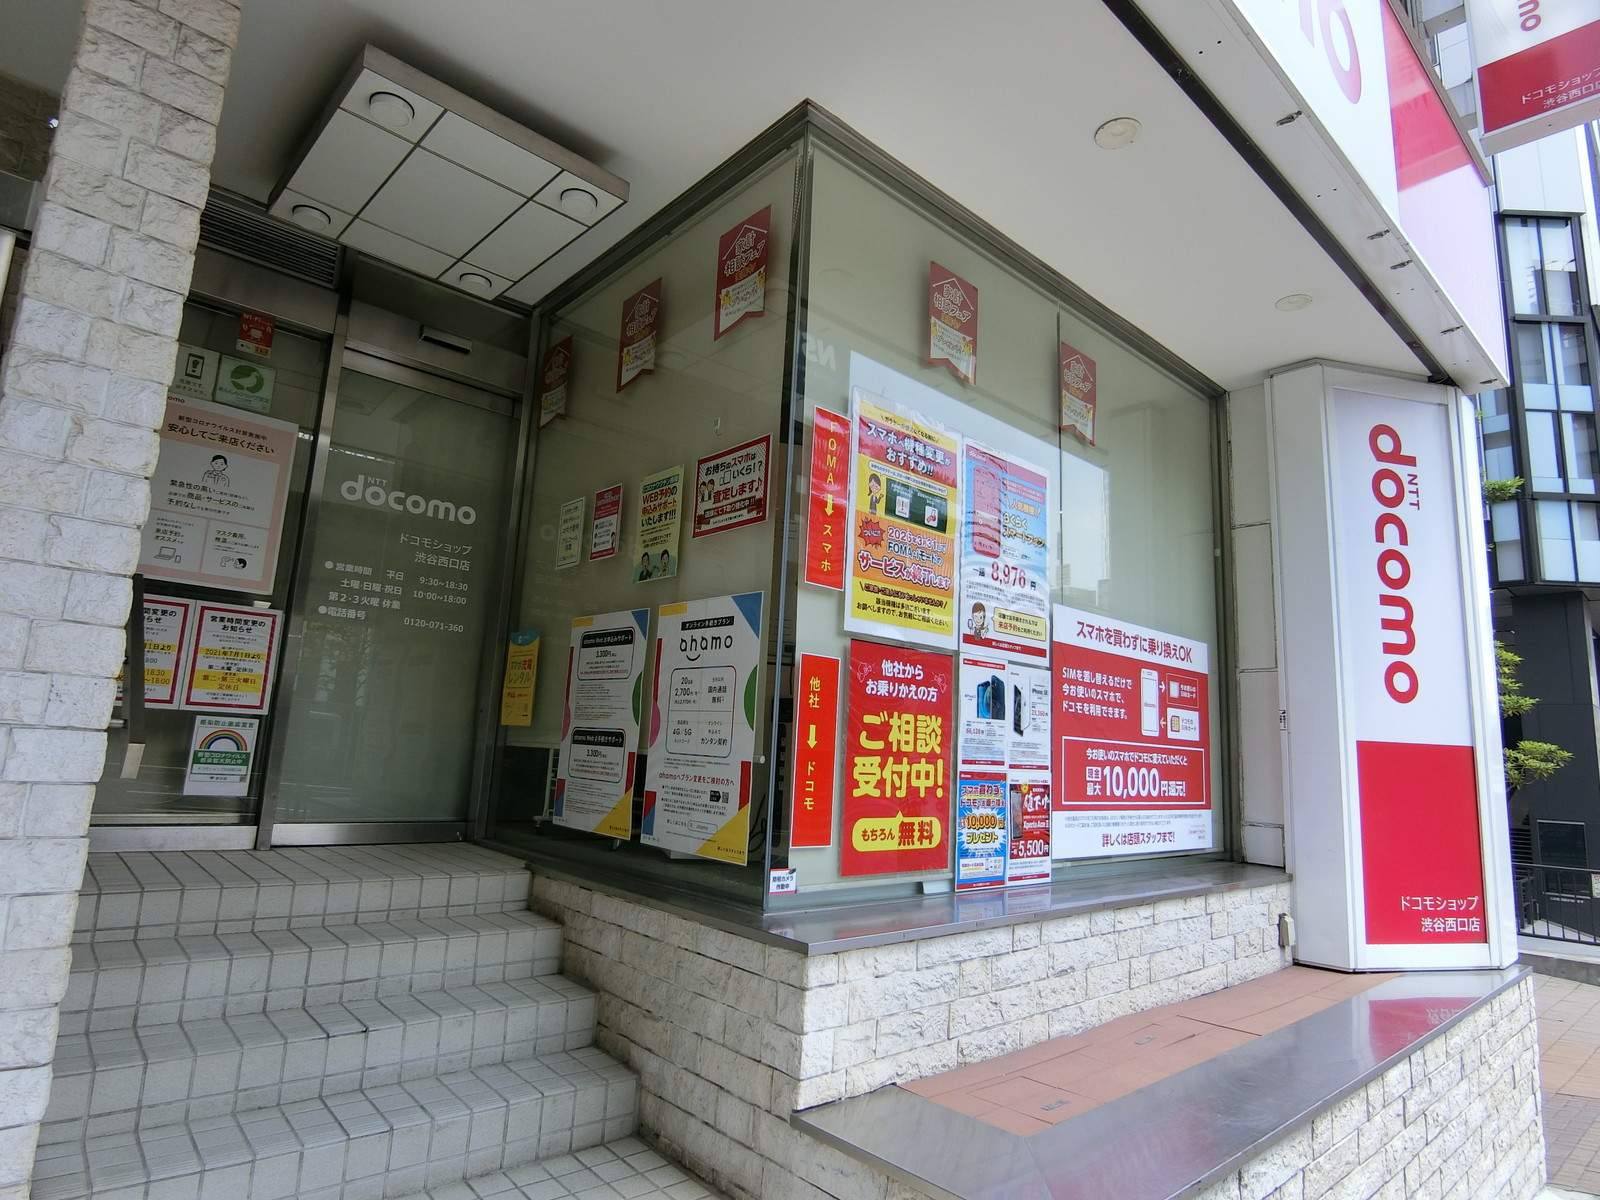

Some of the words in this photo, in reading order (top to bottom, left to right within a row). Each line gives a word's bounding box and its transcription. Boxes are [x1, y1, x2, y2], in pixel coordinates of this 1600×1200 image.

[168, 423, 275, 454] 安心してご来店ください
[826, 421, 838, 485] FOMA
[705, 452, 756, 476] お持ちのスマホは
[367, 476, 388, 487] NTT
[1407, 473, 1420, 511] NTT
[340, 474, 477, 525] docomo
[642, 485, 678, 505] WEB予約の
[641, 498, 677, 516] 申込みサポート
[1003, 511, 1028, 531] らくらく
[400, 532, 473, 555] ドコモショップ
[820, 524, 833, 572] スマホ
[336, 562, 373, 576] 営業時間
[386, 569, 404, 581] 平日
[414, 551, 471, 572] 渋谷西口店
[857, 549, 952, 591] サービスが終了します
[1368, 424, 1419, 704] docomo
[991, 560, 1026, 589] 8,976
[1030, 580, 1037, 591] 円
[210, 615, 266, 628] 営業時間変更の
[221, 624, 253, 634] お知らせ
[327, 606, 367, 621] 電話番号
[404, 617, 464, 633] 0120-071-360
[679, 634, 733, 652] ahamo
[1076, 620, 1193, 664] スマホを買わずに乗り換えOK
[205, 648, 261, 659] 2021年7月1日より
[881, 659, 924, 680] 他社から
[1062, 666, 1132, 690] SIMを差し替えるだけで
[217, 683, 239, 691] 定休日
[808, 676, 821, 709] 他社
[865, 679, 938, 703] お乗りかえの方
[1062, 683, 1125, 704] 今お使いのスマホで、
[1062, 700, 1128, 720] ドコモを利用できます。
[700, 738, 728, 746] カンタン契約
[859, 710, 943, 755] ご相談
[198, 751, 246, 759] 新型コロナウイルス
[803, 760, 816, 811] ドコモ
[852, 755, 944, 798] 受付中!
[961, 783, 1004, 796] スマホ買わずに
[861, 827, 896, 842] もちろん
[898, 820, 934, 847] 無料
[965, 831, 999, 845] プレゼント
[1400, 895, 1479, 911] ドコモショップ
[1420, 917, 1481, 932] 渋谷西口店
